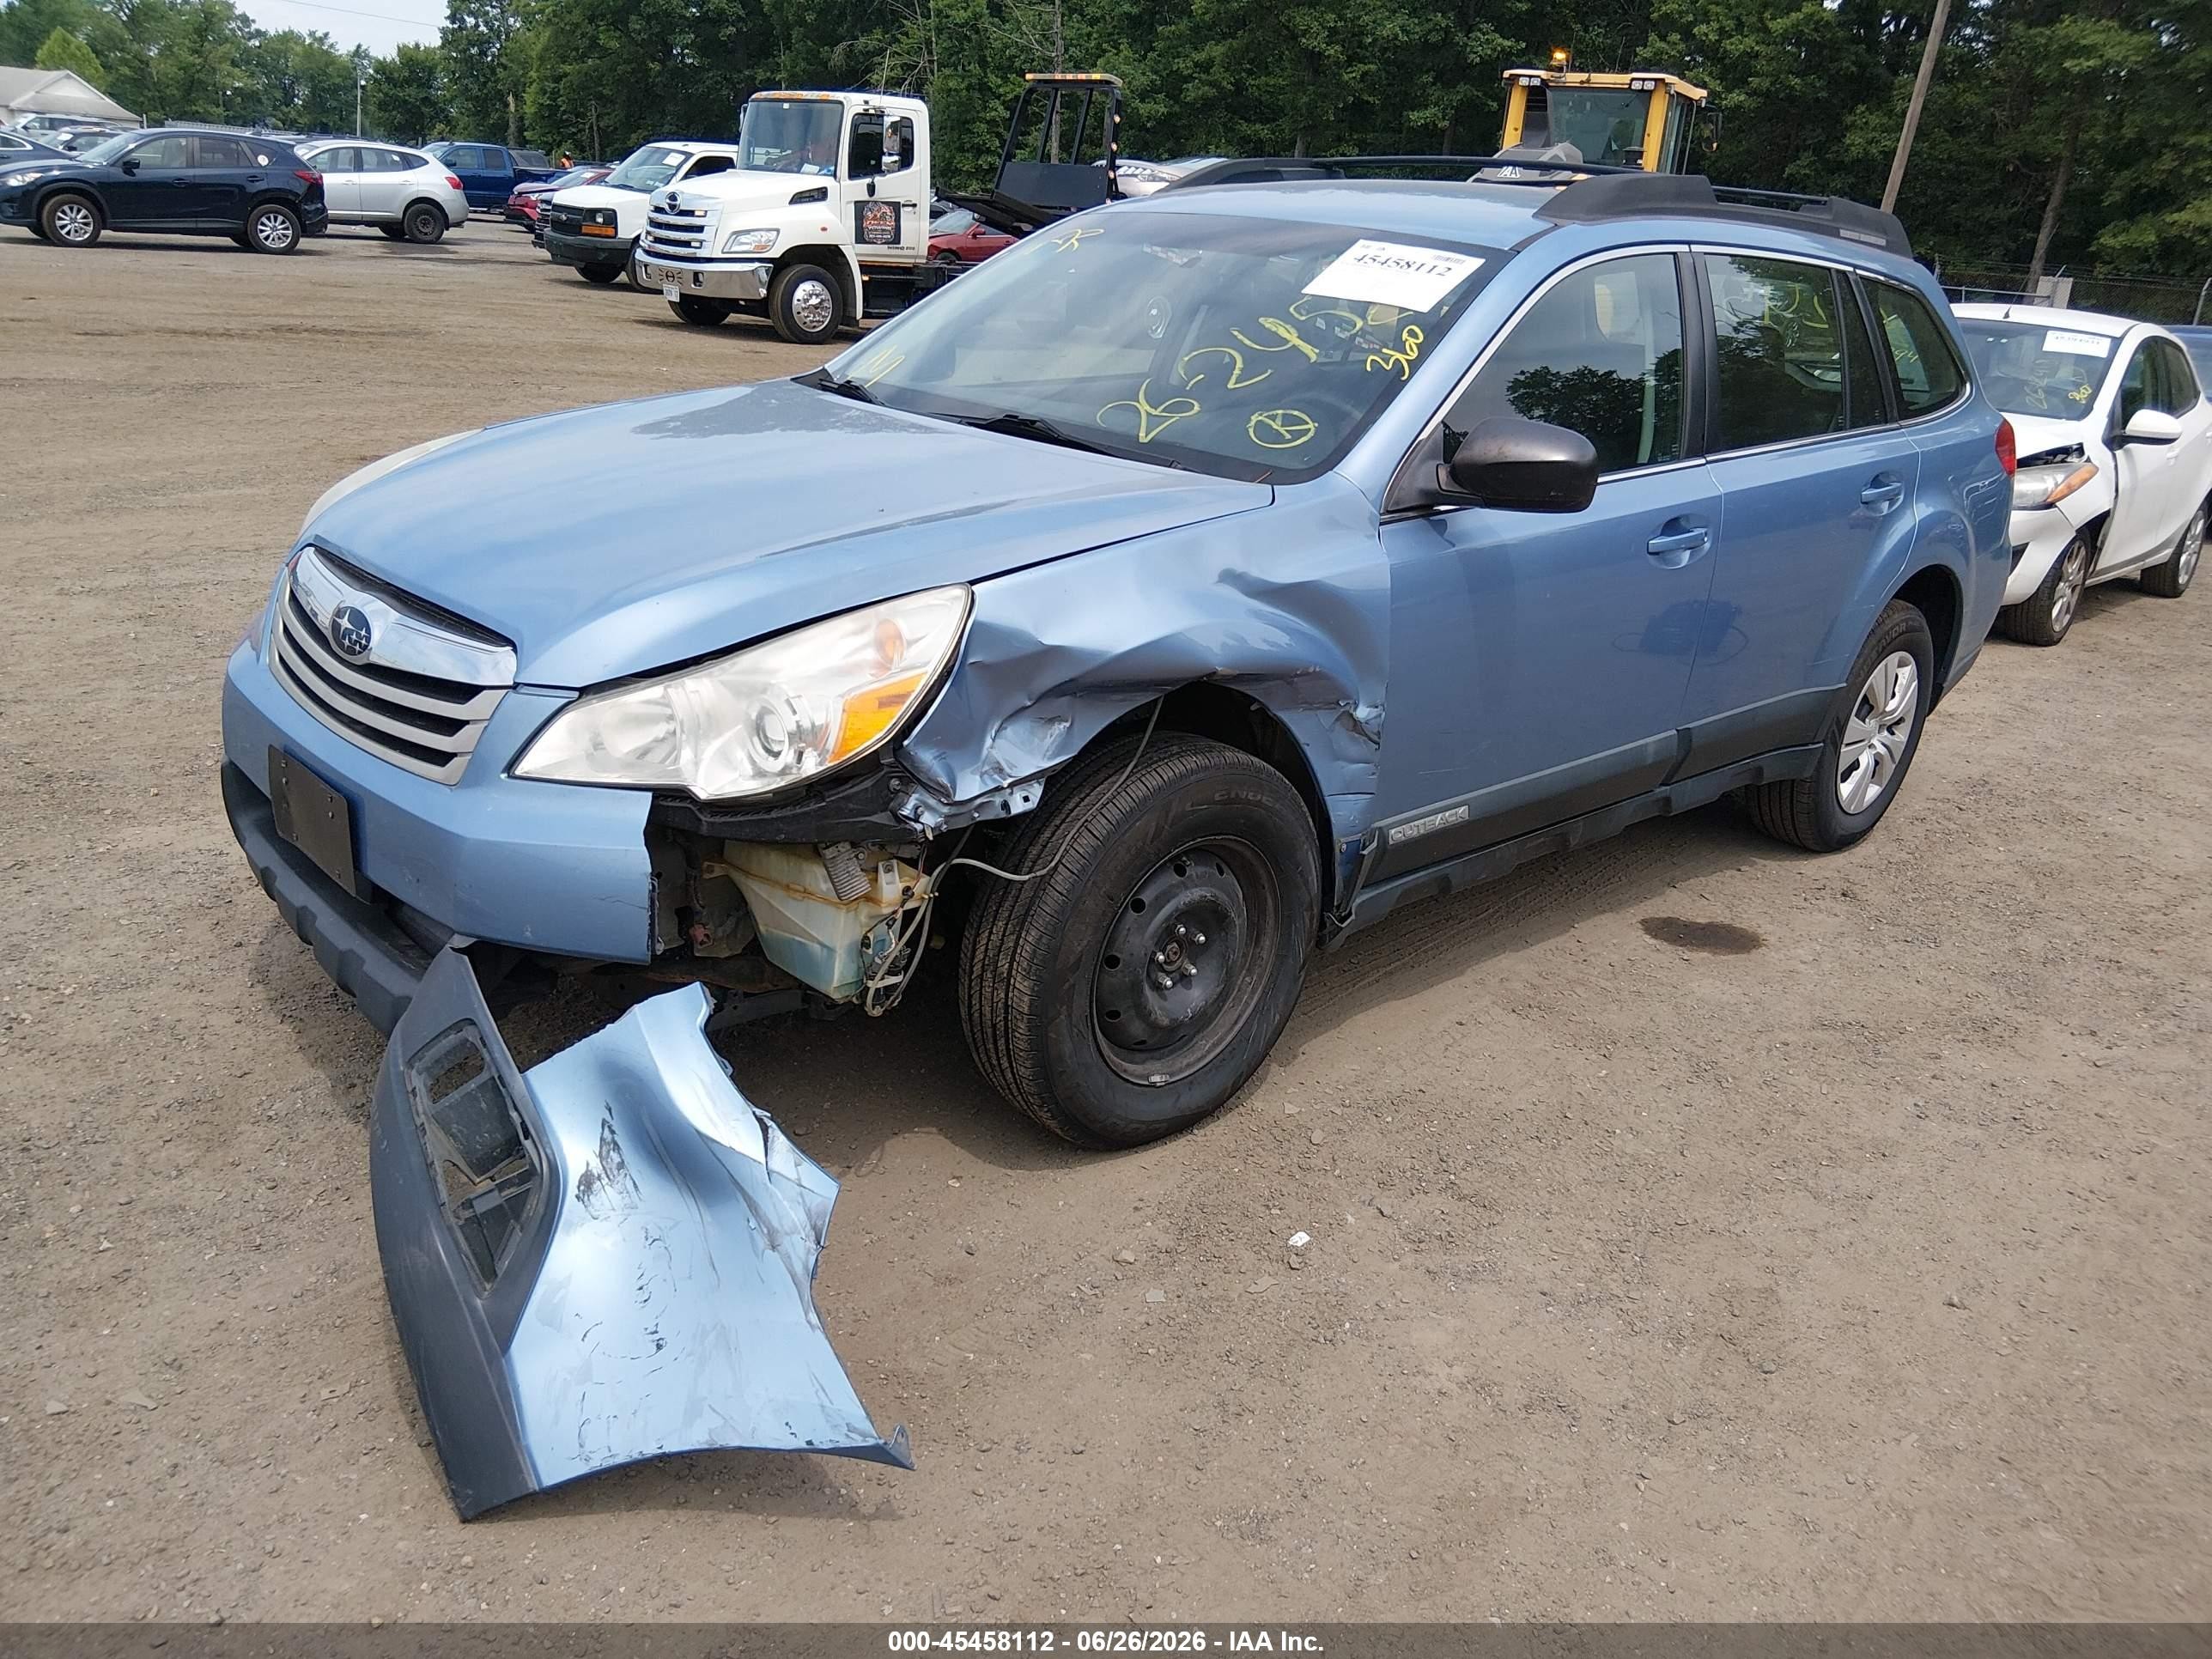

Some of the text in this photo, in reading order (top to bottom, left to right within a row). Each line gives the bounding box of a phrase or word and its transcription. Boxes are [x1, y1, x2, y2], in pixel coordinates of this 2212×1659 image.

[1353, 253, 1453, 276] 45458112
[1366, 325, 1425, 380] 360
[1389, 807, 1468, 842] OUTBACK
